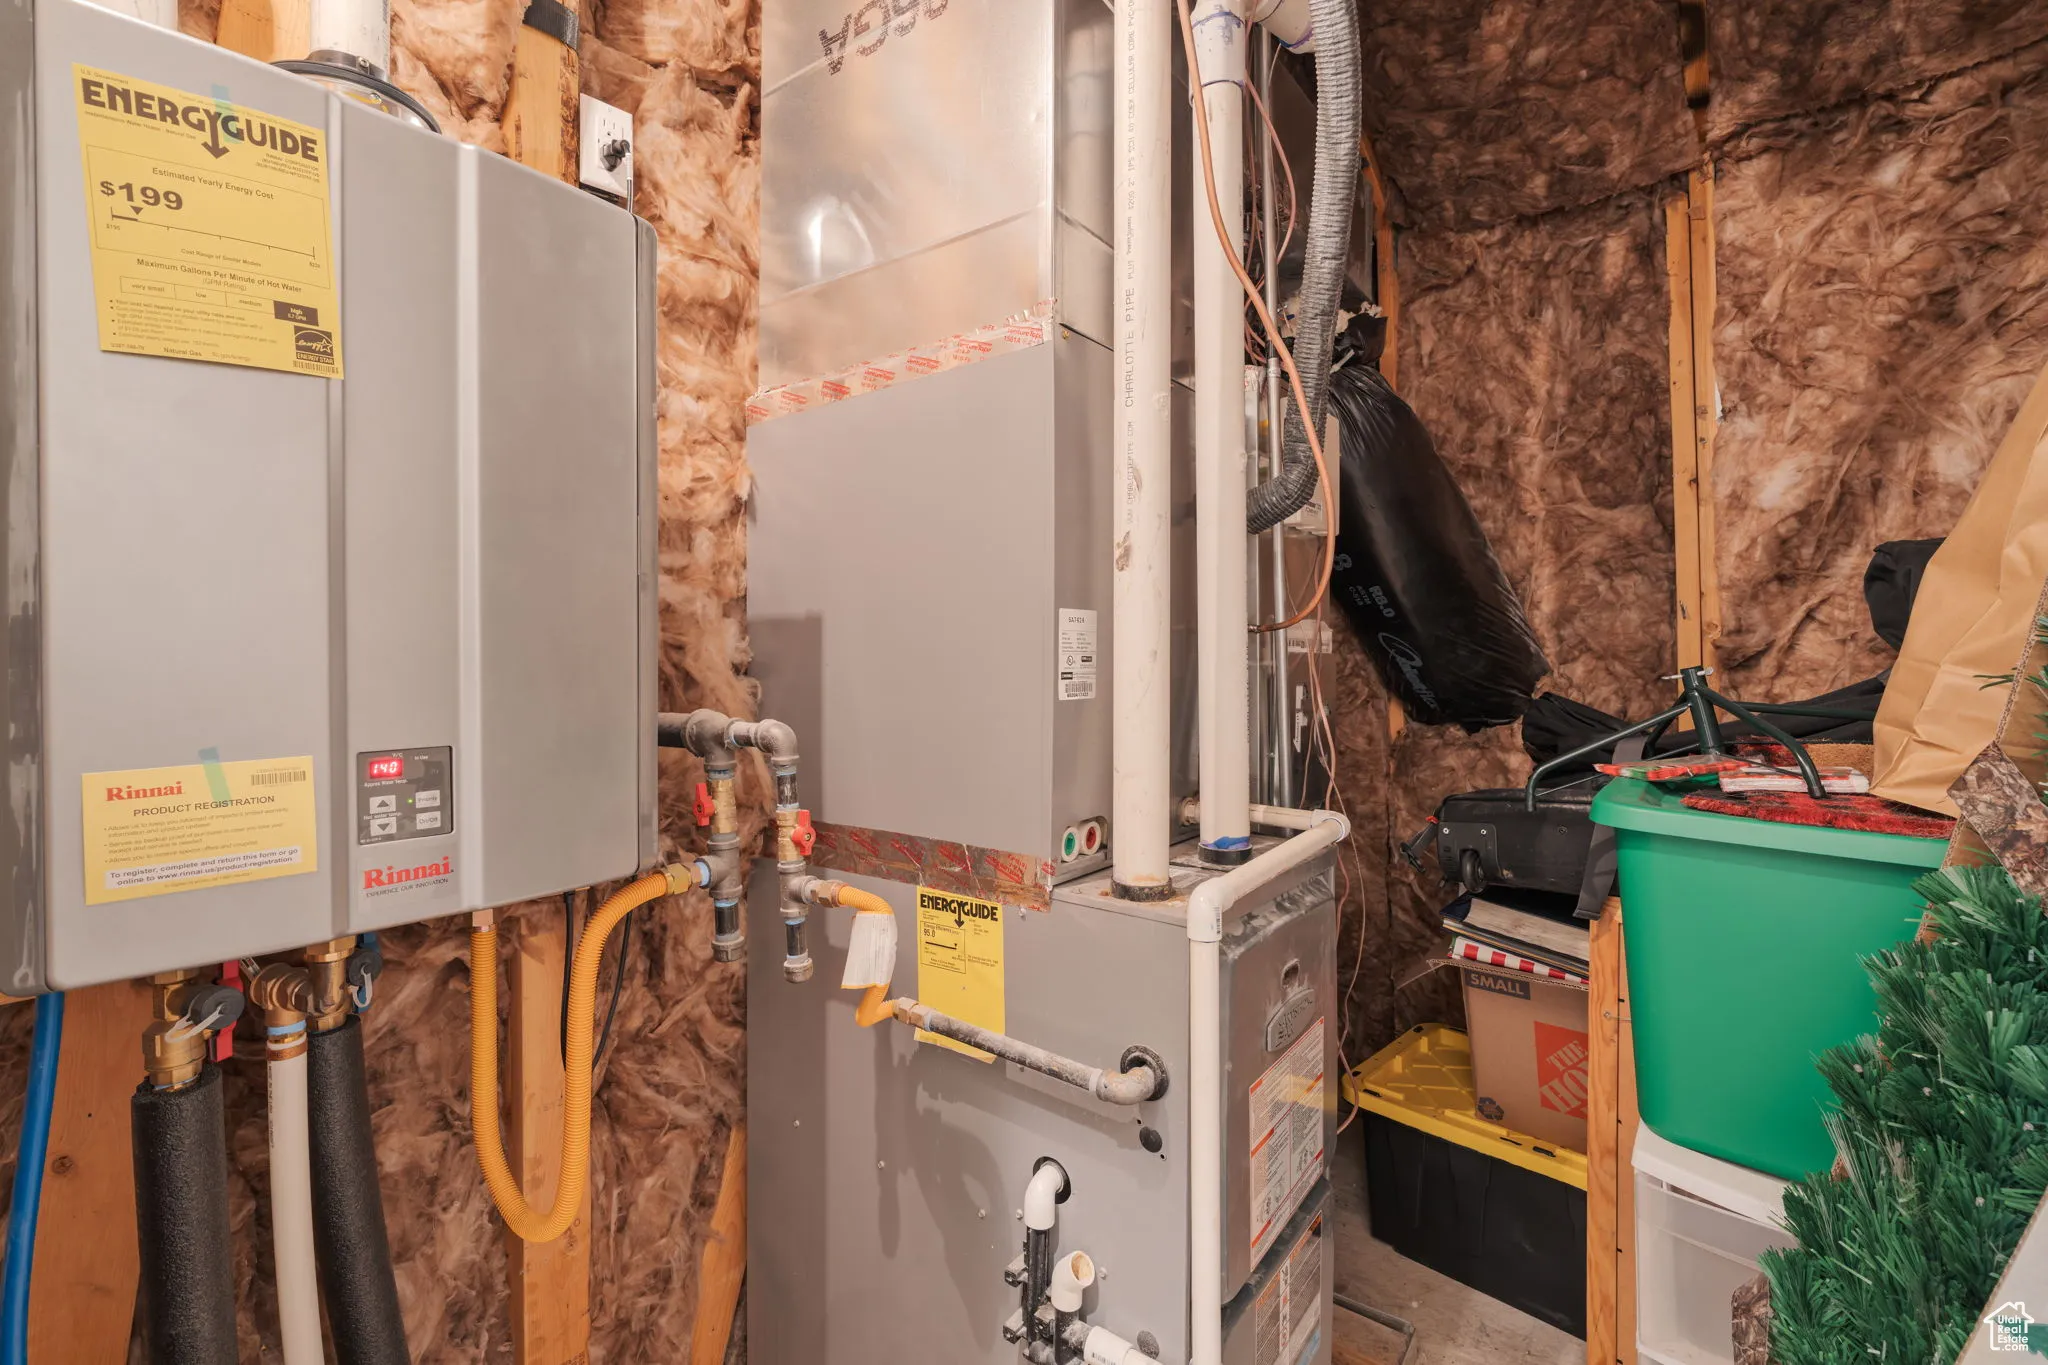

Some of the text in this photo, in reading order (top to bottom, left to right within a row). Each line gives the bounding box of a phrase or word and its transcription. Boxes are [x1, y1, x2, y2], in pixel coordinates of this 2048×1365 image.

[100, 180, 183, 211] $199
[152, 167, 275, 200] Estimated Yearly Energy Cost
[136, 258, 302, 293] Maximum Gallons Per Minute of Hot Water
[1124, 288, 1135, 322] PIPE
[163, 346, 188, 356] Natural
[189, 348, 202, 357] Gas
[1124, 330, 1135, 408] CHARLOTTE
[1369, 585, 1396, 618] R8.0
[373, 761, 398, 774] 140
[105, 780, 183, 802] Rinnai
[133, 795, 275, 817] PRODUCT REGISTRATION
[122, 867, 159, 878] register,
[160, 861, 199, 872] complete
[200, 859, 216, 867] and
[217, 856, 241, 865] return
[242, 853, 258, 861] this
[259, 851, 277, 859] form
[288, 848, 298, 856] go
[363, 856, 451, 889] Rinnai
[117, 876, 145, 886] online
[366, 887, 399, 898] EXPERIENCE
[415, 878, 449, 889] INNOVATION
[920, 893, 999, 924] ENERGYGUIDE
[923, 928, 936, 938] 95.0
[1470, 973, 1524, 995] SMALL
[1546, 1040, 1588, 1072] THE
